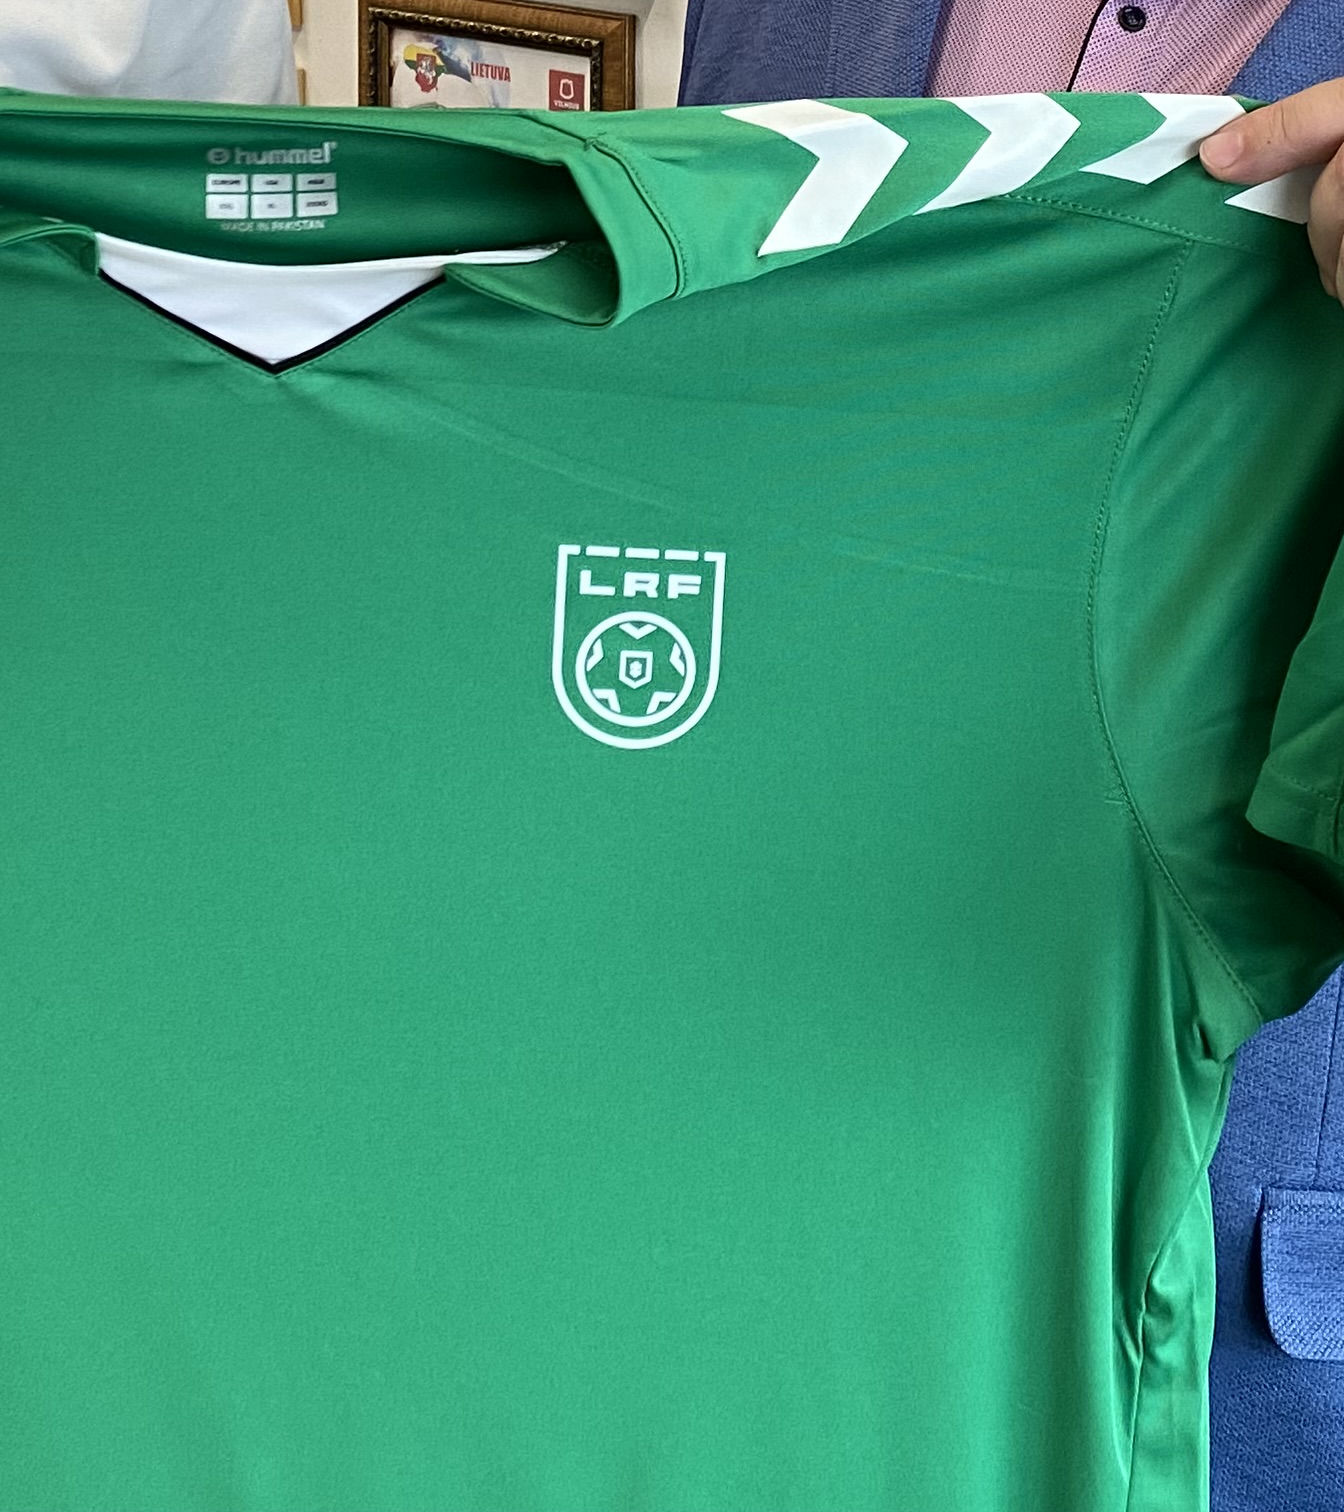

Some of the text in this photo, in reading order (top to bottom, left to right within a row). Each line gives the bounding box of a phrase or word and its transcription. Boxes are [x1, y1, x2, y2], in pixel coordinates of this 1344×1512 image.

[470, 60, 512, 83] LIETUVA
[234, 141, 337, 165] hummel
[579, 569, 702, 599] LRF
